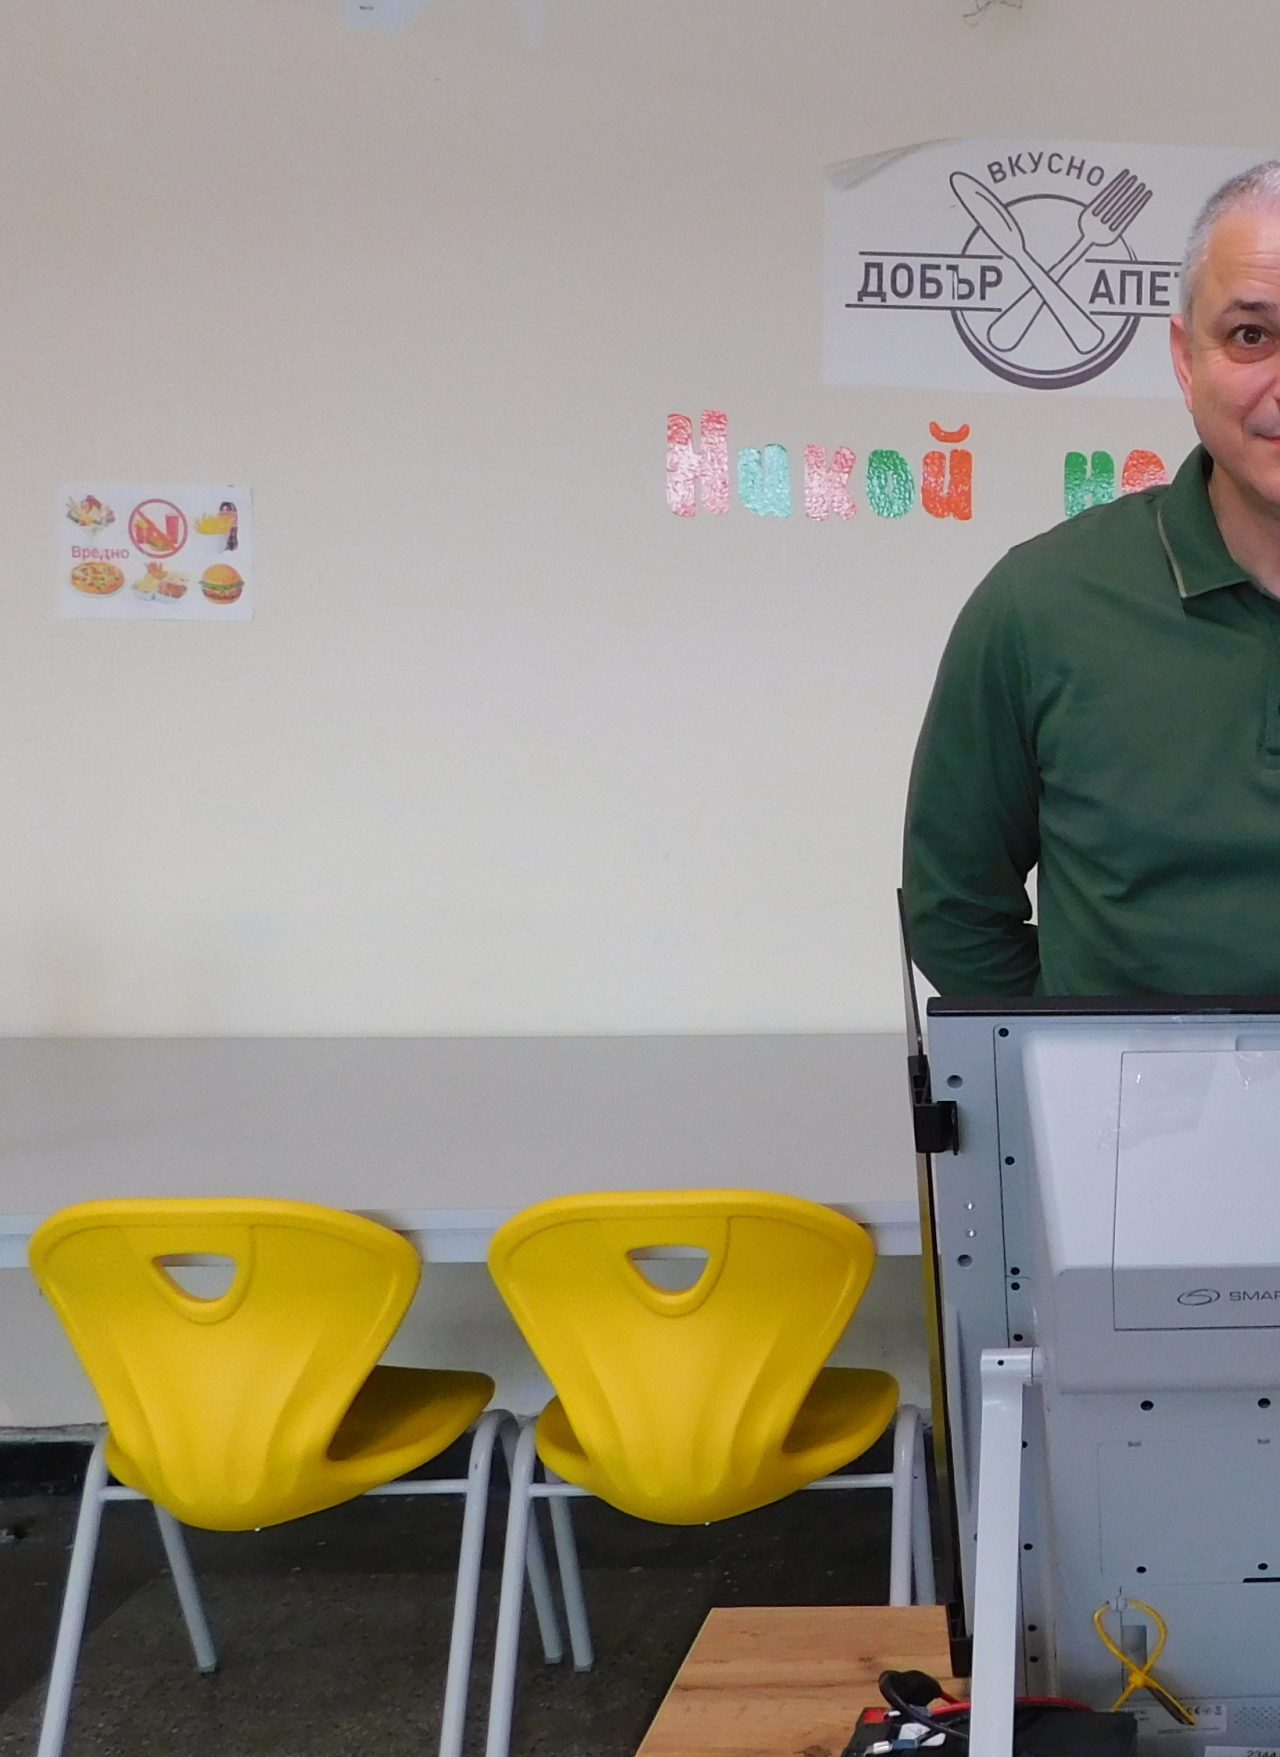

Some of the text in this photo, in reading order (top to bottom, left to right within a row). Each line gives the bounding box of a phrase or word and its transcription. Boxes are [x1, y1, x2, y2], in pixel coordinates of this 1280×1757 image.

[986, 151, 1106, 188] ВКУСНО
[857, 261, 1180, 307] ДОБЪР АПЕ
[666, 409, 974, 521] Никой
[71, 545, 130, 561] Вредно
